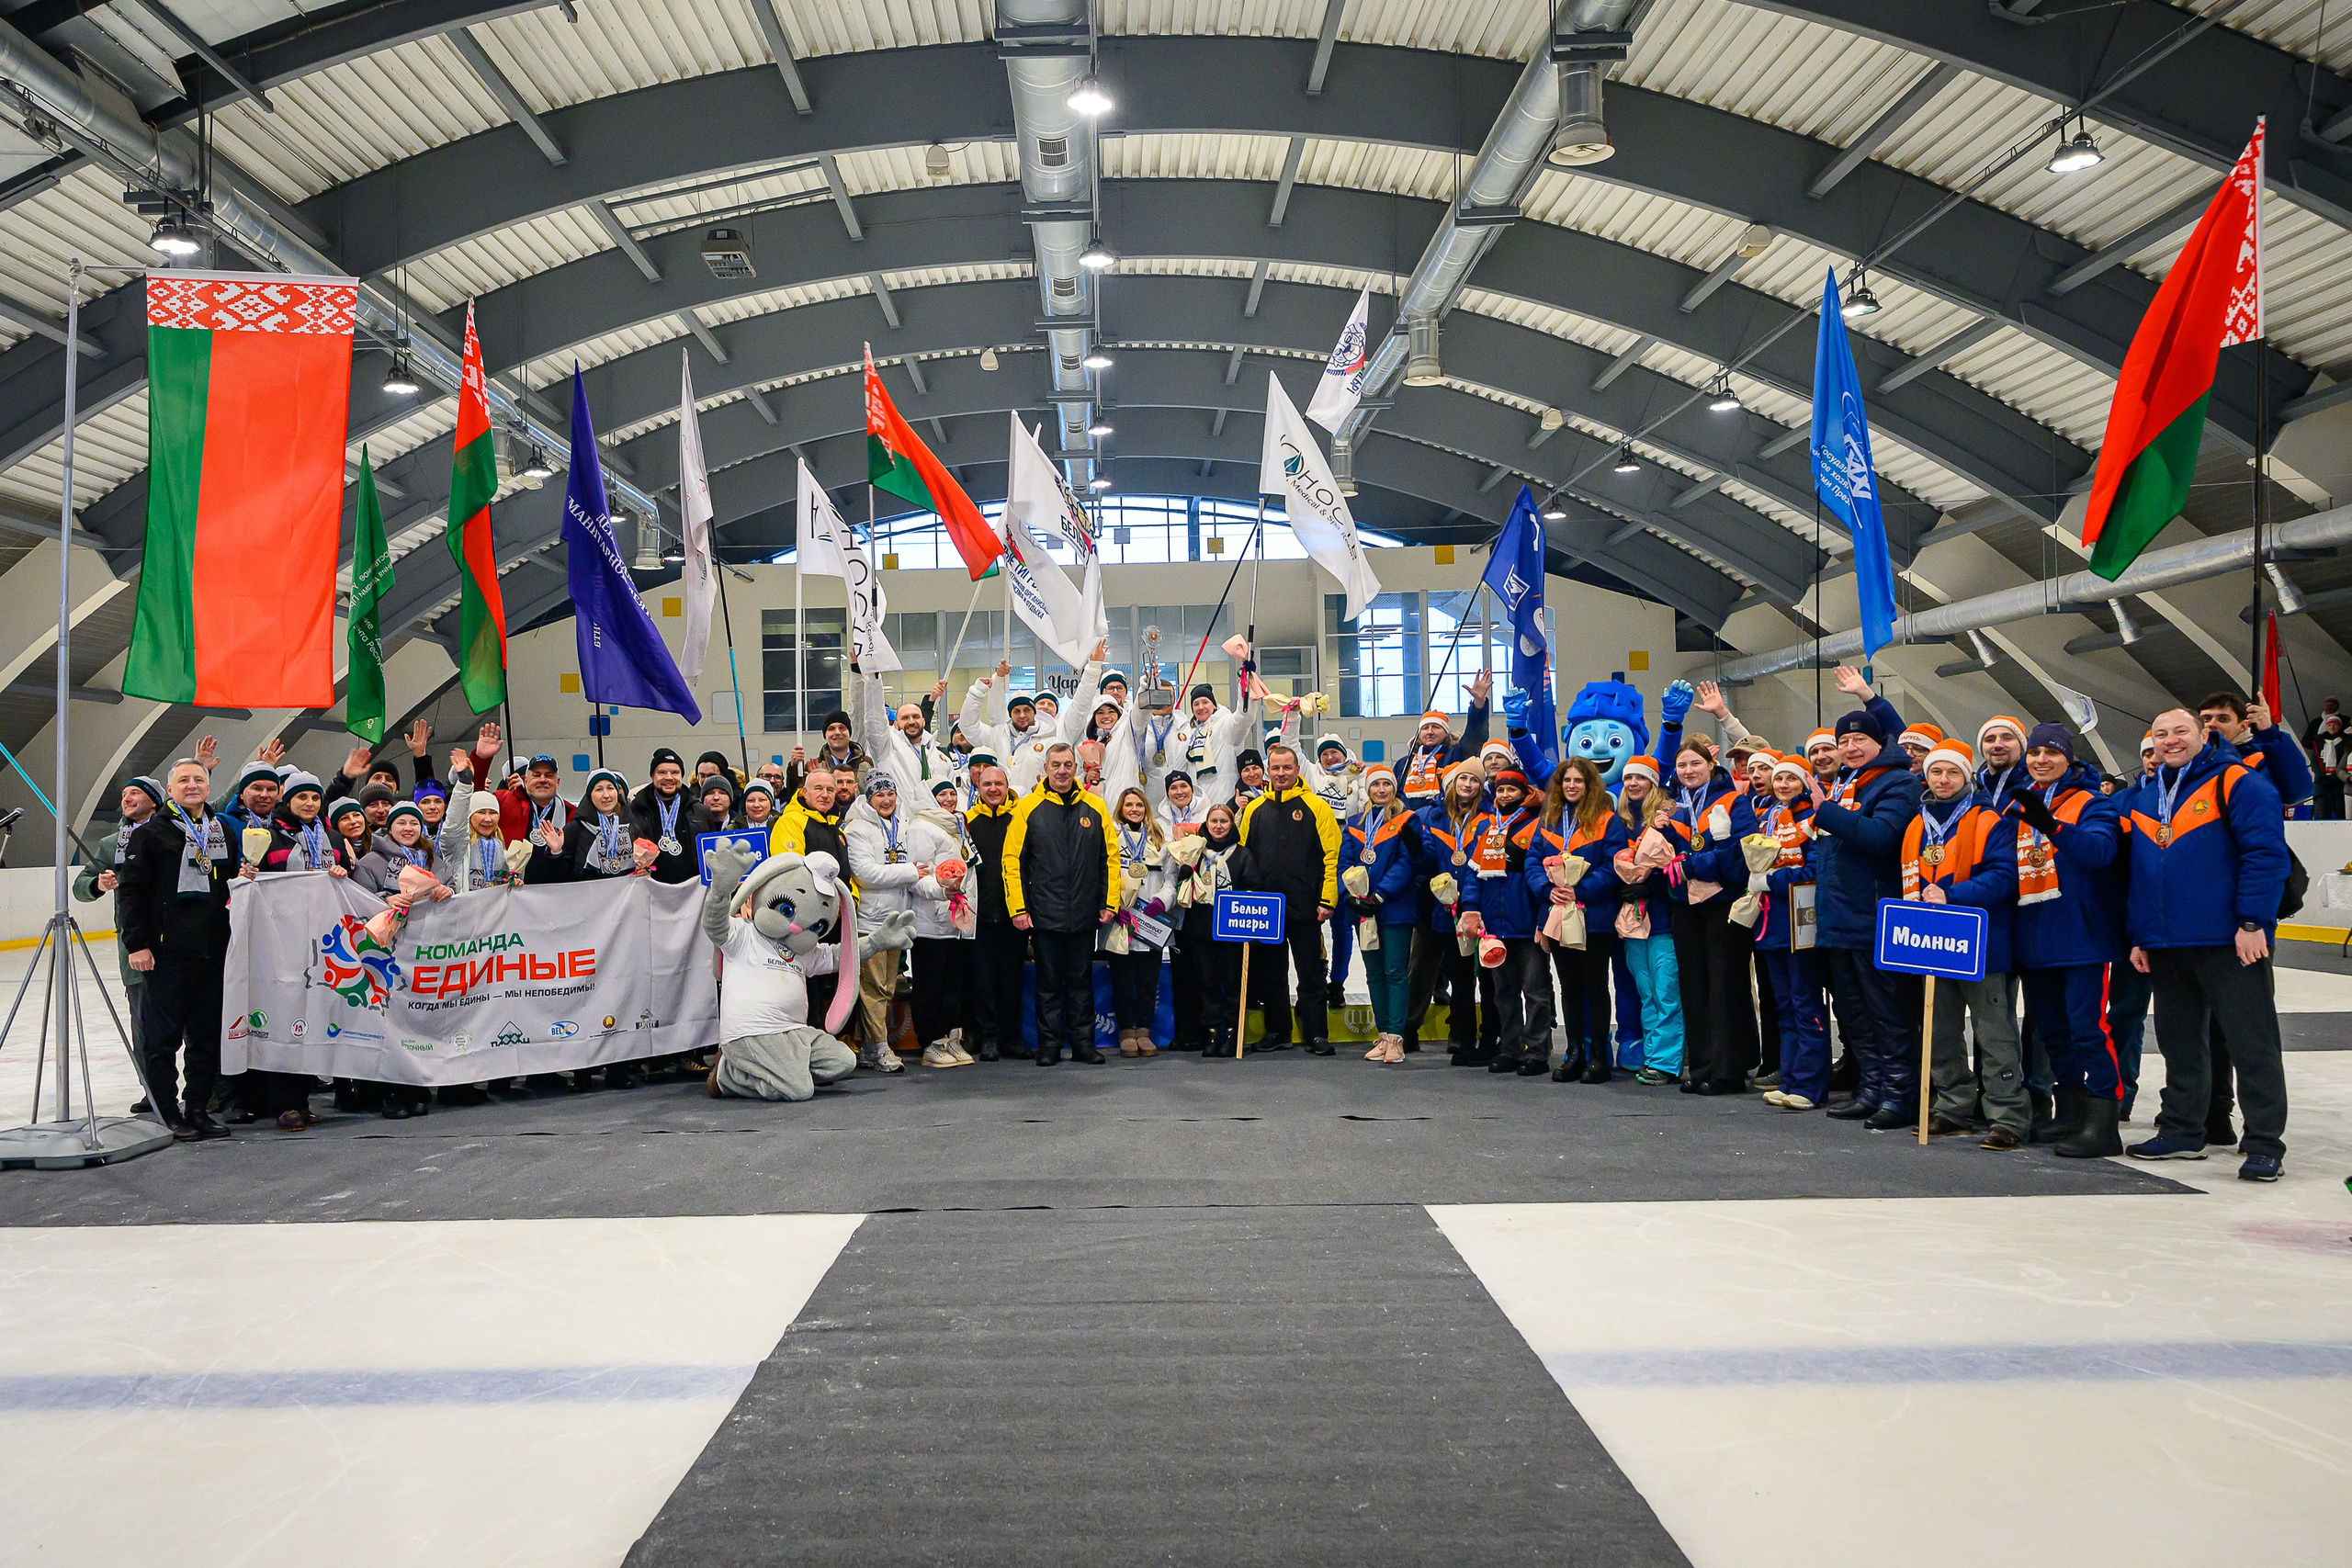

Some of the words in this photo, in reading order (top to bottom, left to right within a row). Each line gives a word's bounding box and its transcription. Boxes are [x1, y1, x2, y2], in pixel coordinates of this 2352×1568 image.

[1291, 479, 1321, 510] Medical
[1231, 900, 1268, 916] Белые
[1228, 919, 1270, 933] тигры
[1893, 925, 1969, 954] Молния
[415, 932, 525, 960] КОМАНДА
[411, 948, 596, 999] ЕДИНЫЕ
[408, 1001, 439, 1011] КОГДА
[441, 998, 458, 1010] МЫ
[459, 993, 491, 1007] ЕДИНЫ
[504, 990, 522, 998] МЫ
[525, 982, 595, 998] НЕПОБЕДИМЫ!
